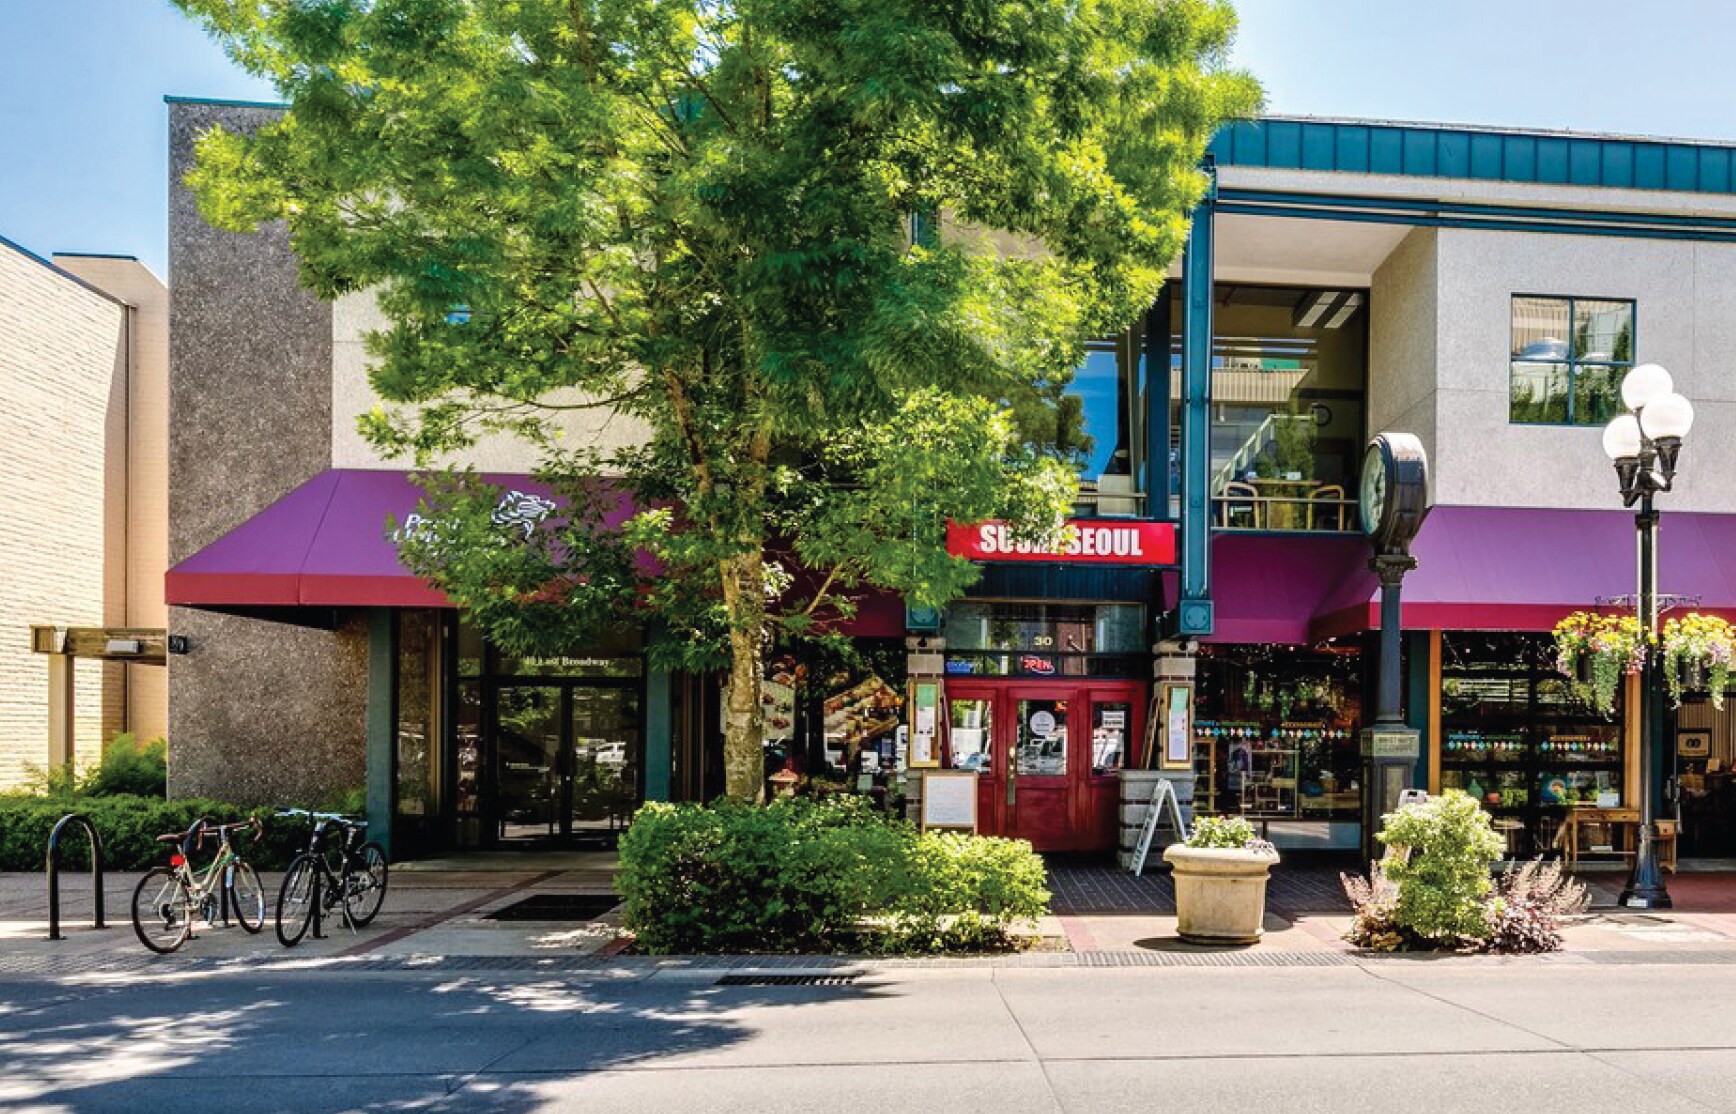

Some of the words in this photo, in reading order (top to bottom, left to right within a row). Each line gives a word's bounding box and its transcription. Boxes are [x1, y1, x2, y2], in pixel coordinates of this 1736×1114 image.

[980, 525, 1059, 554] SUS
[1065, 527, 1143, 556] SEOUL
[1033, 635, 1053, 646] 30
[562, 656, 609, 668] Broadway
